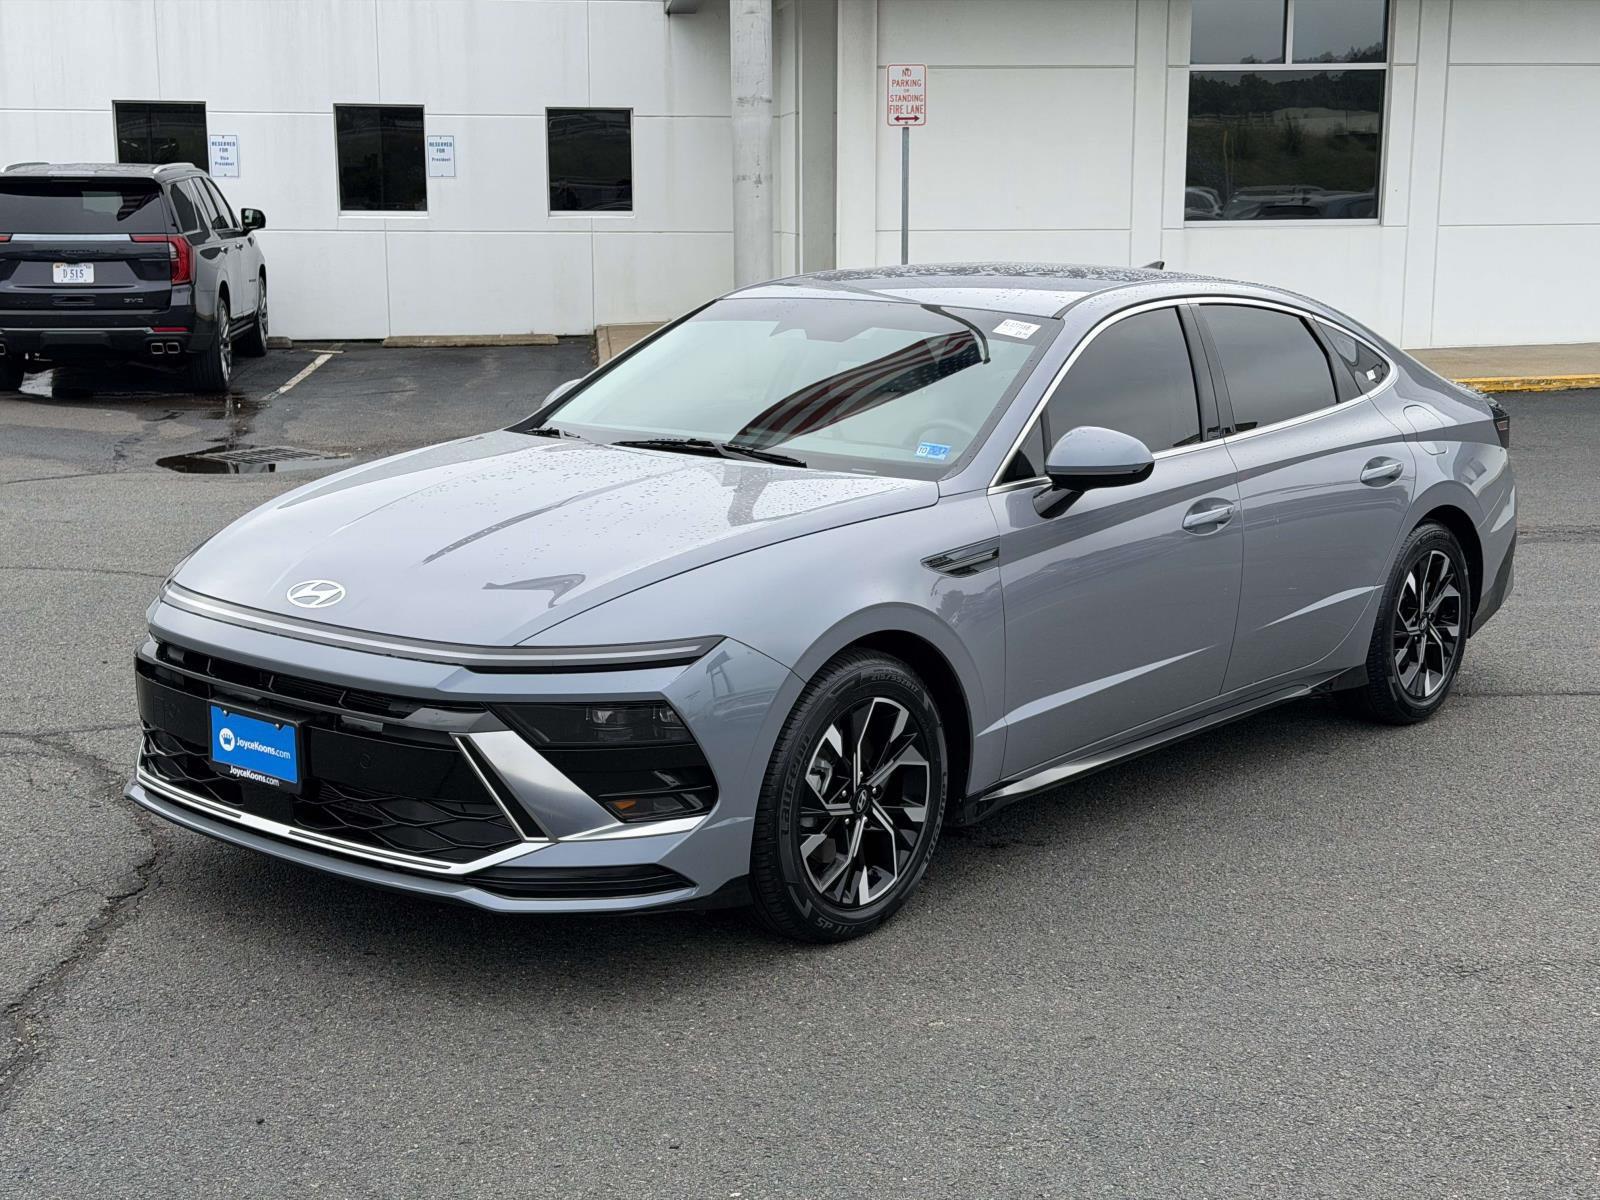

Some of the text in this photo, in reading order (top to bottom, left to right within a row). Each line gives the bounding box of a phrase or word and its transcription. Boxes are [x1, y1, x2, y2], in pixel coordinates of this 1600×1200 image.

[902, 68, 912, 77] NO
[891, 79, 922, 88] PARKING
[889, 94, 924, 103] STANDING
[889, 104, 924, 115] FIRE LANE
[236, 737, 291, 759] JoyceKoons.com
[229, 765, 280, 786] JoyceKoons.com
